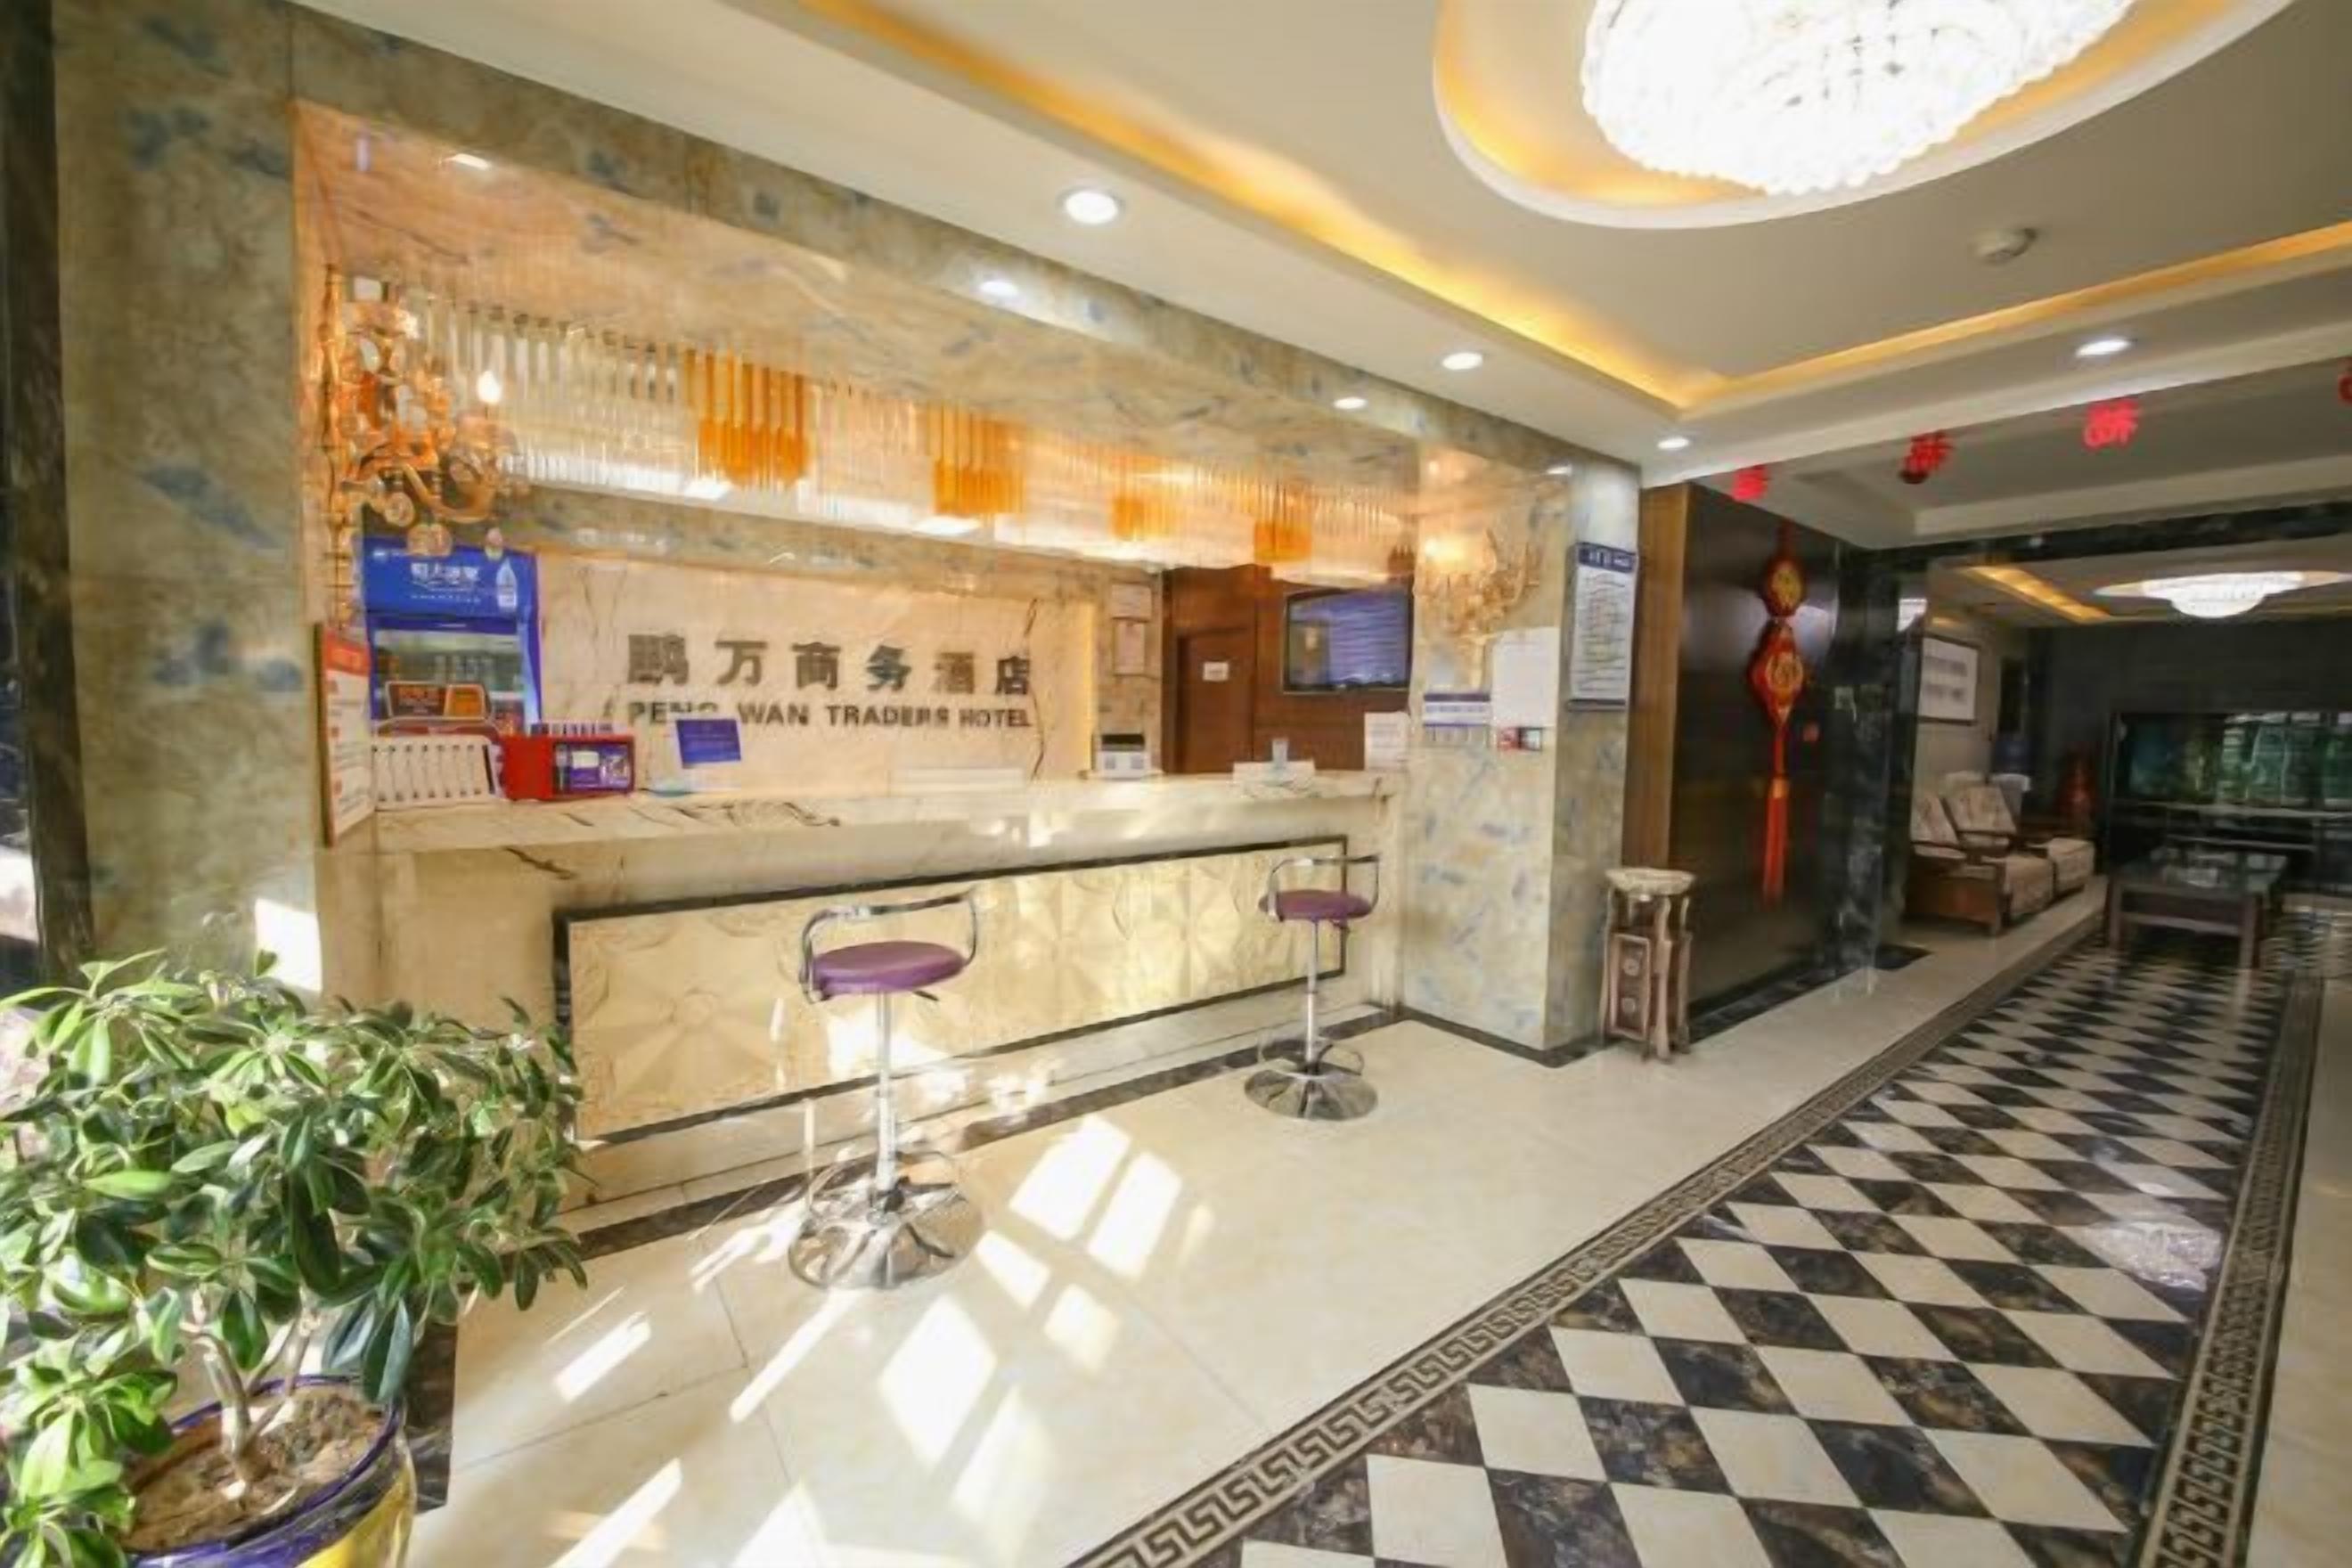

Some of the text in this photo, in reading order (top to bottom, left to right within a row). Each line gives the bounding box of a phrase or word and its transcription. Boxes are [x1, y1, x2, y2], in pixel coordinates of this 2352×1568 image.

[738, 703, 809, 726] WAN
[825, 705, 950, 728] TRADERS
[959, 708, 1033, 728] HOTEL
